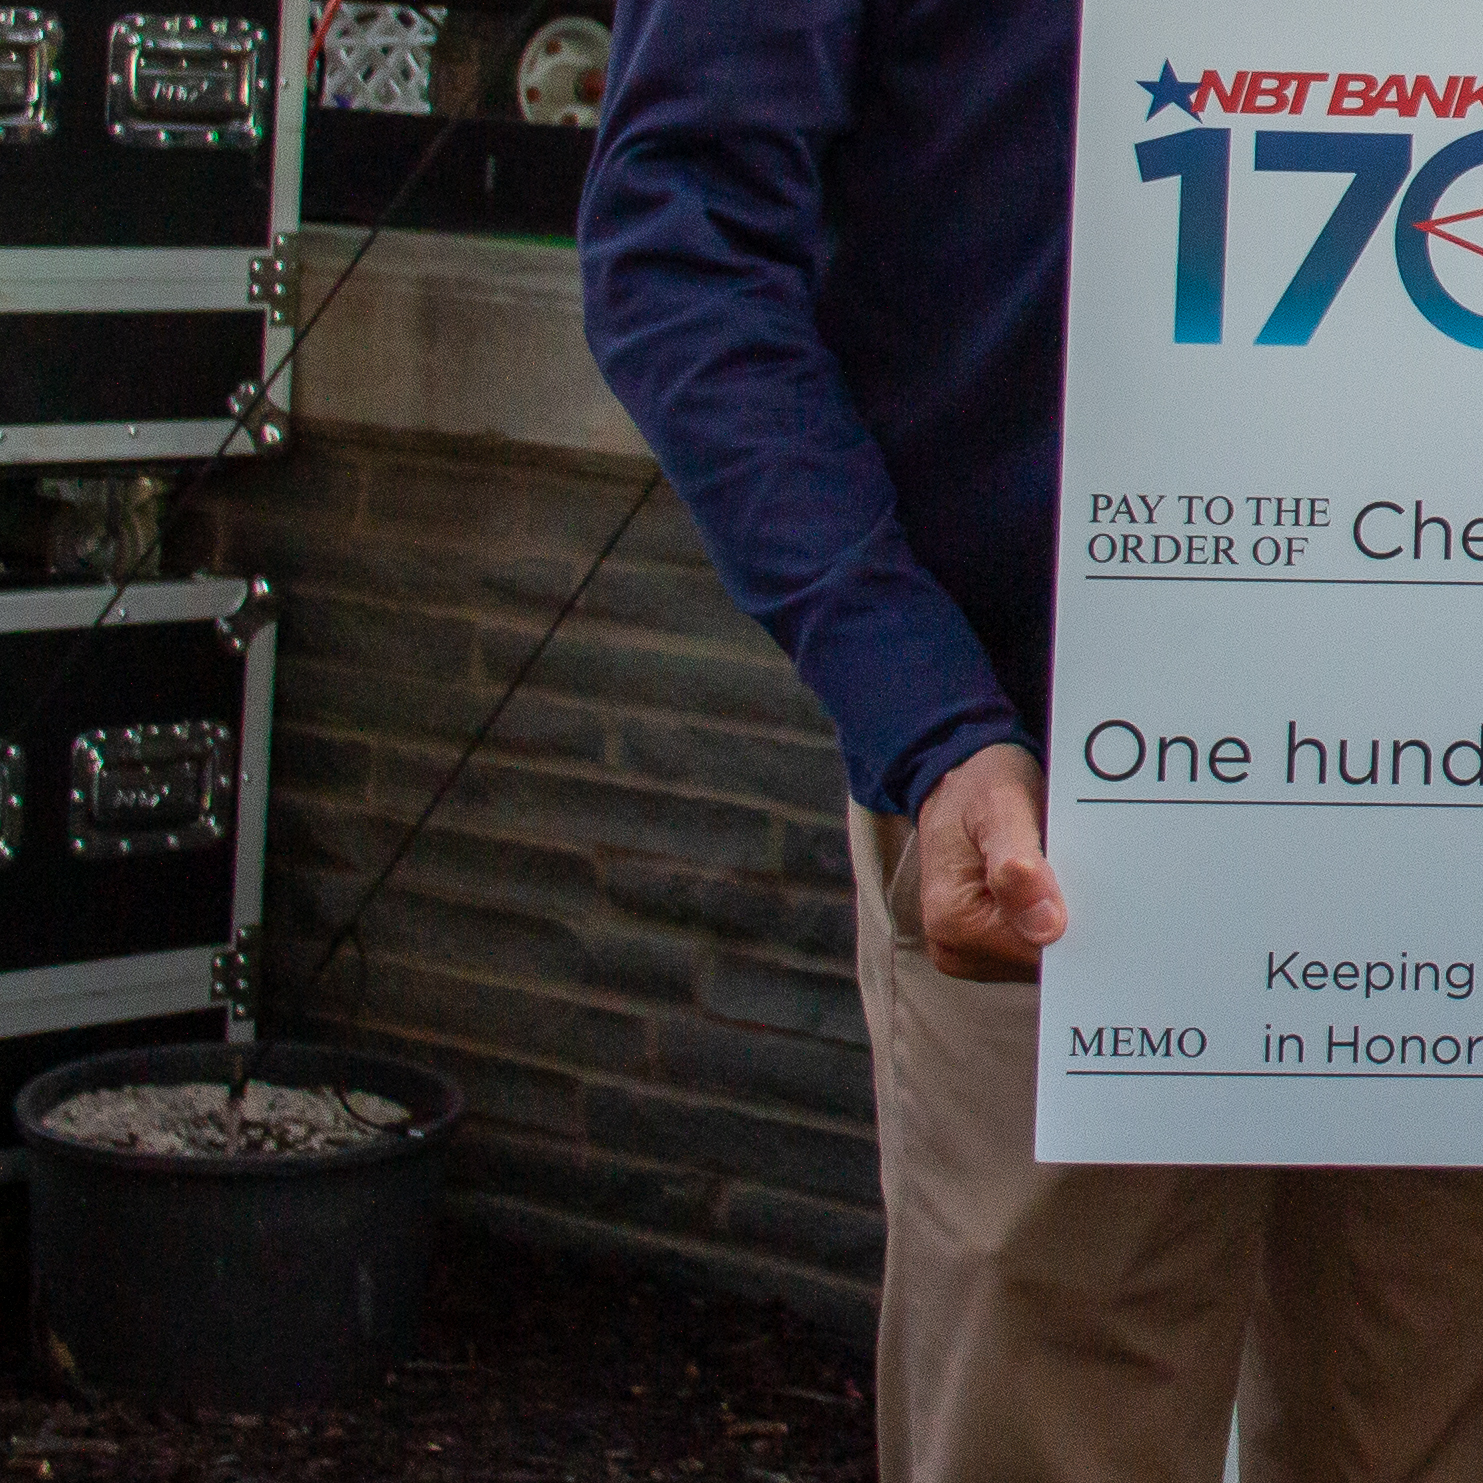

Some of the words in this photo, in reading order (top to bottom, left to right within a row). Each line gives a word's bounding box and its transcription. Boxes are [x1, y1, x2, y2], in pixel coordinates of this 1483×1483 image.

[1190, 68, 1331, 116] NBT
[1089, 493, 1165, 525] PAY
[1177, 495, 1234, 526] TO
[1245, 496, 1330, 528] THE
[1086, 533, 1237, 566] ORDER
[1250, 536, 1308, 567] OF
[1082, 719, 1251, 785] One
[1265, 951, 1475, 1001] Keeping
[1070, 1026, 1207, 1059] MEMO
[1263, 1023, 1304, 1064] in
[1325, 1025, 1483, 1067] Honor
